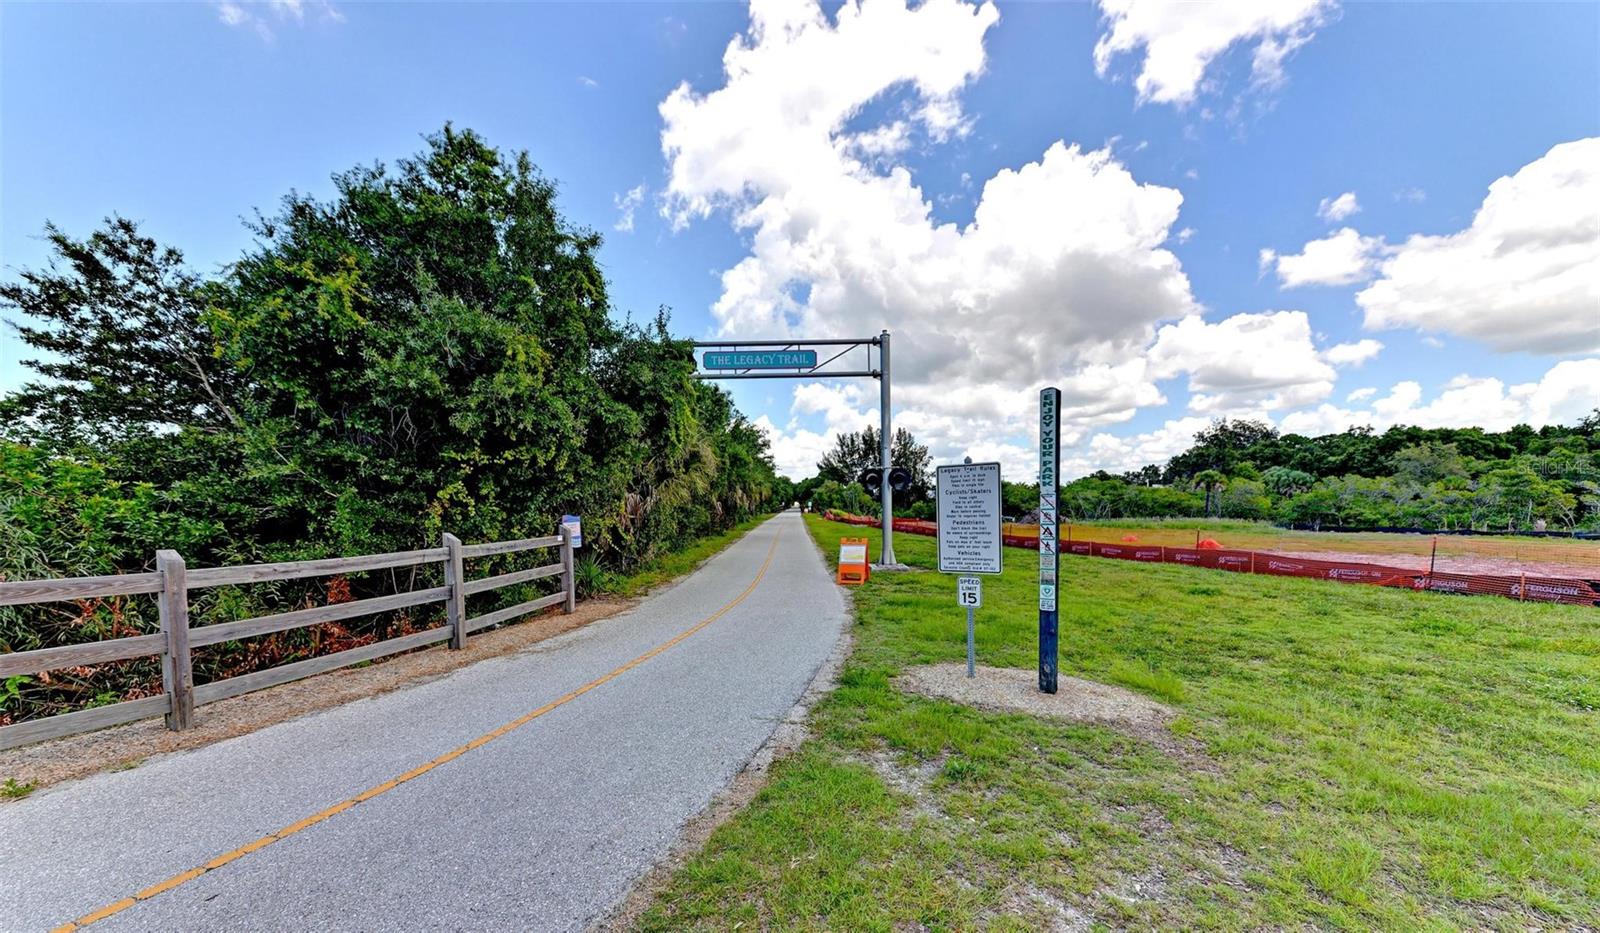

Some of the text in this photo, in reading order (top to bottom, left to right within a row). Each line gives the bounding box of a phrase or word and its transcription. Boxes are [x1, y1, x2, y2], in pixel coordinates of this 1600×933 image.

[711, 353, 809, 365] THE LEGACY TRAIL
[1042, 394, 1054, 427] ENJOY
[1042, 430, 1054, 458] YOUR
[1042, 460, 1053, 487] PARK
[962, 592, 977, 604] 15
[1526, 584, 1578, 596] FERGUSON
